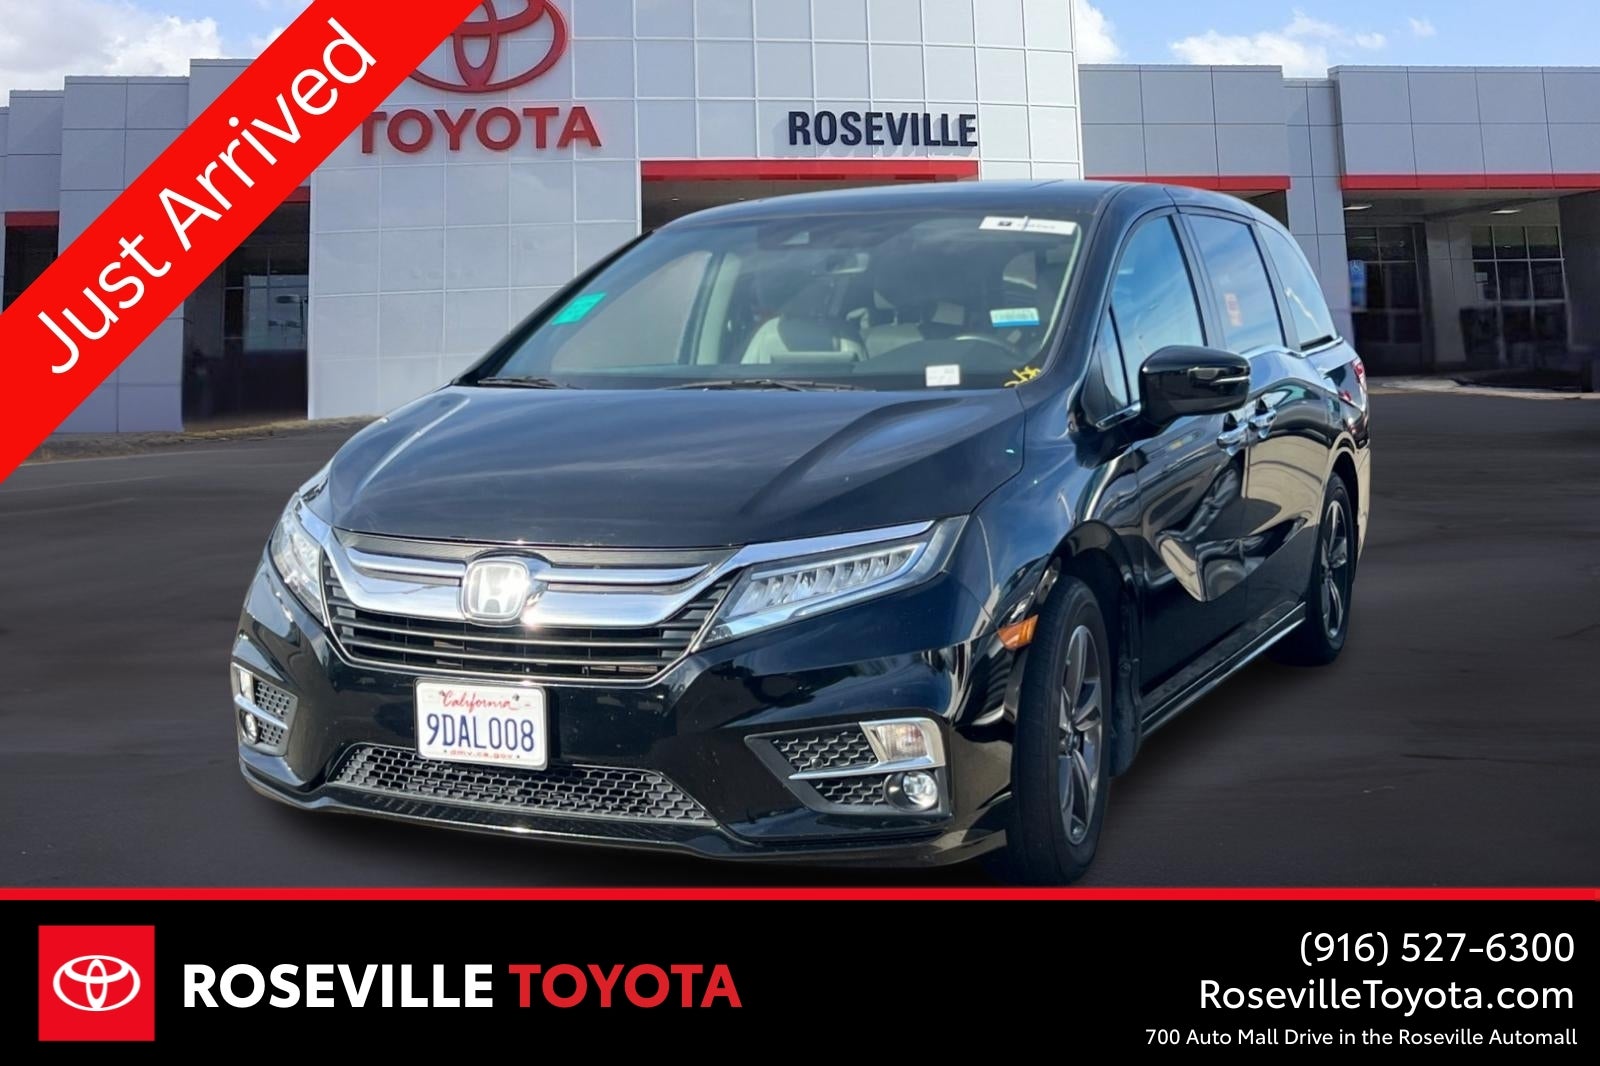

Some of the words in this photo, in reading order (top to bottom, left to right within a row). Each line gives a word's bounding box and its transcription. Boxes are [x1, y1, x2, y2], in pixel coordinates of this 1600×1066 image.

[361, 106, 602, 154] TOYOTA
[788, 110, 978, 147] ROSEVILLE
[440, 689, 519, 713] California
[426, 712, 535, 753] 9DAL008
